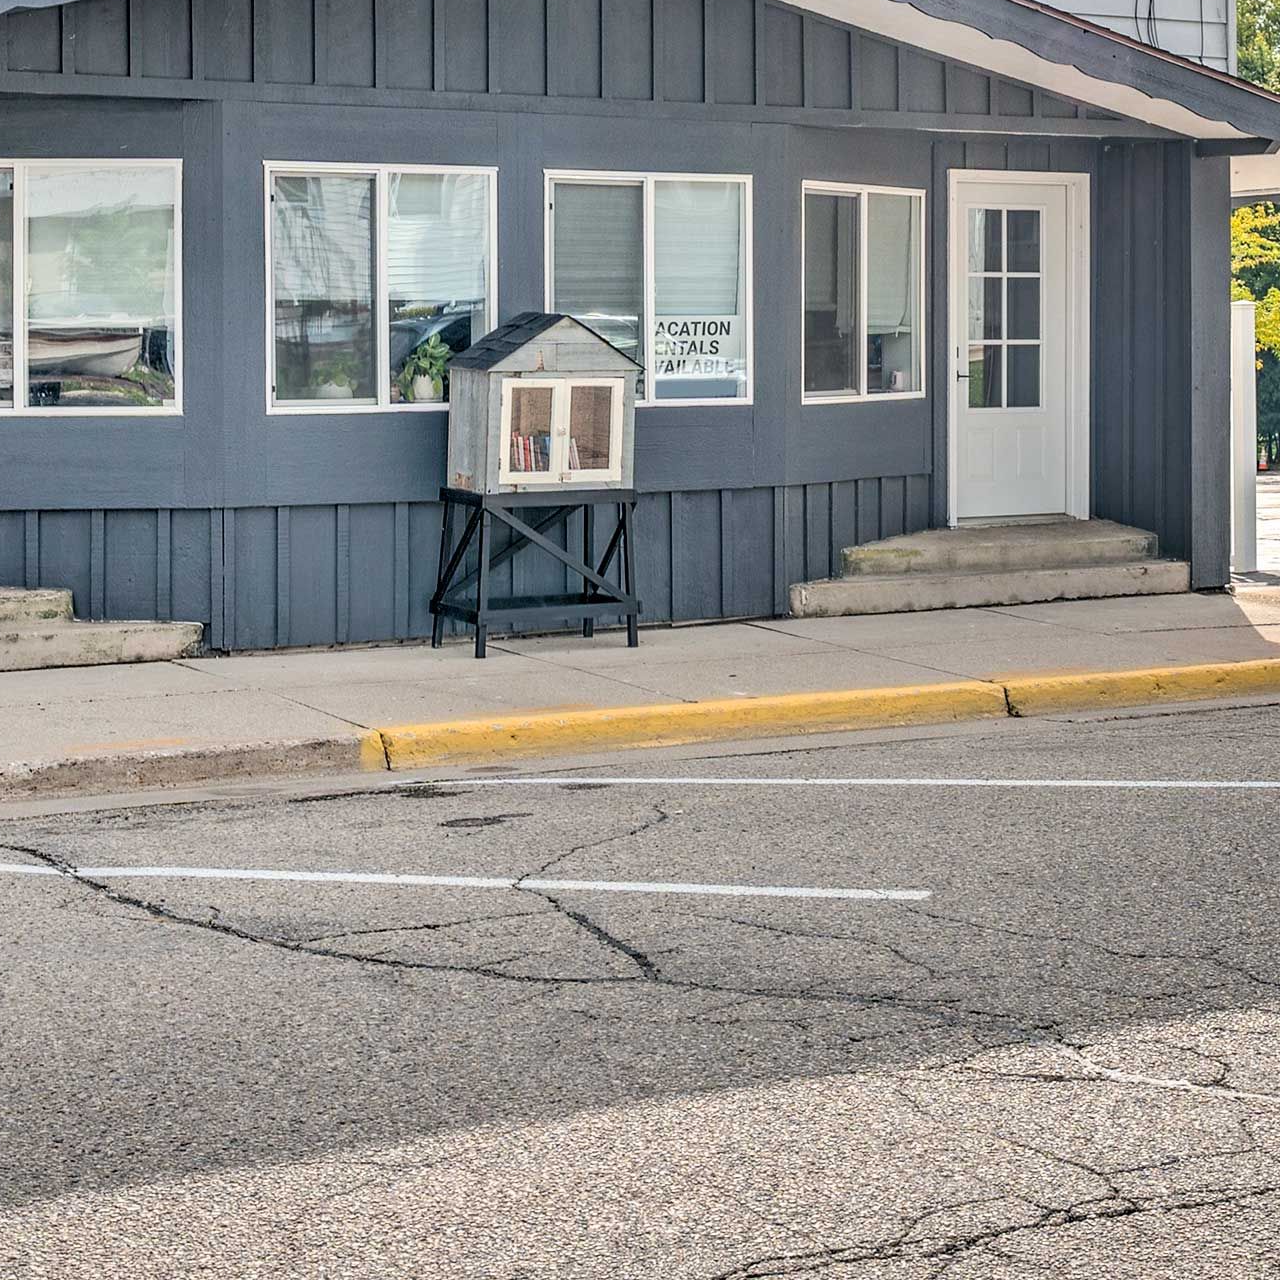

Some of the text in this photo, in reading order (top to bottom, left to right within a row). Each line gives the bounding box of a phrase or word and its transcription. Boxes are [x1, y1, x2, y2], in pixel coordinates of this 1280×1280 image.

[655, 321, 731, 336] ACATION
[655, 340, 720, 355] ENTALS
[655, 359, 735, 375] VAILABLE
